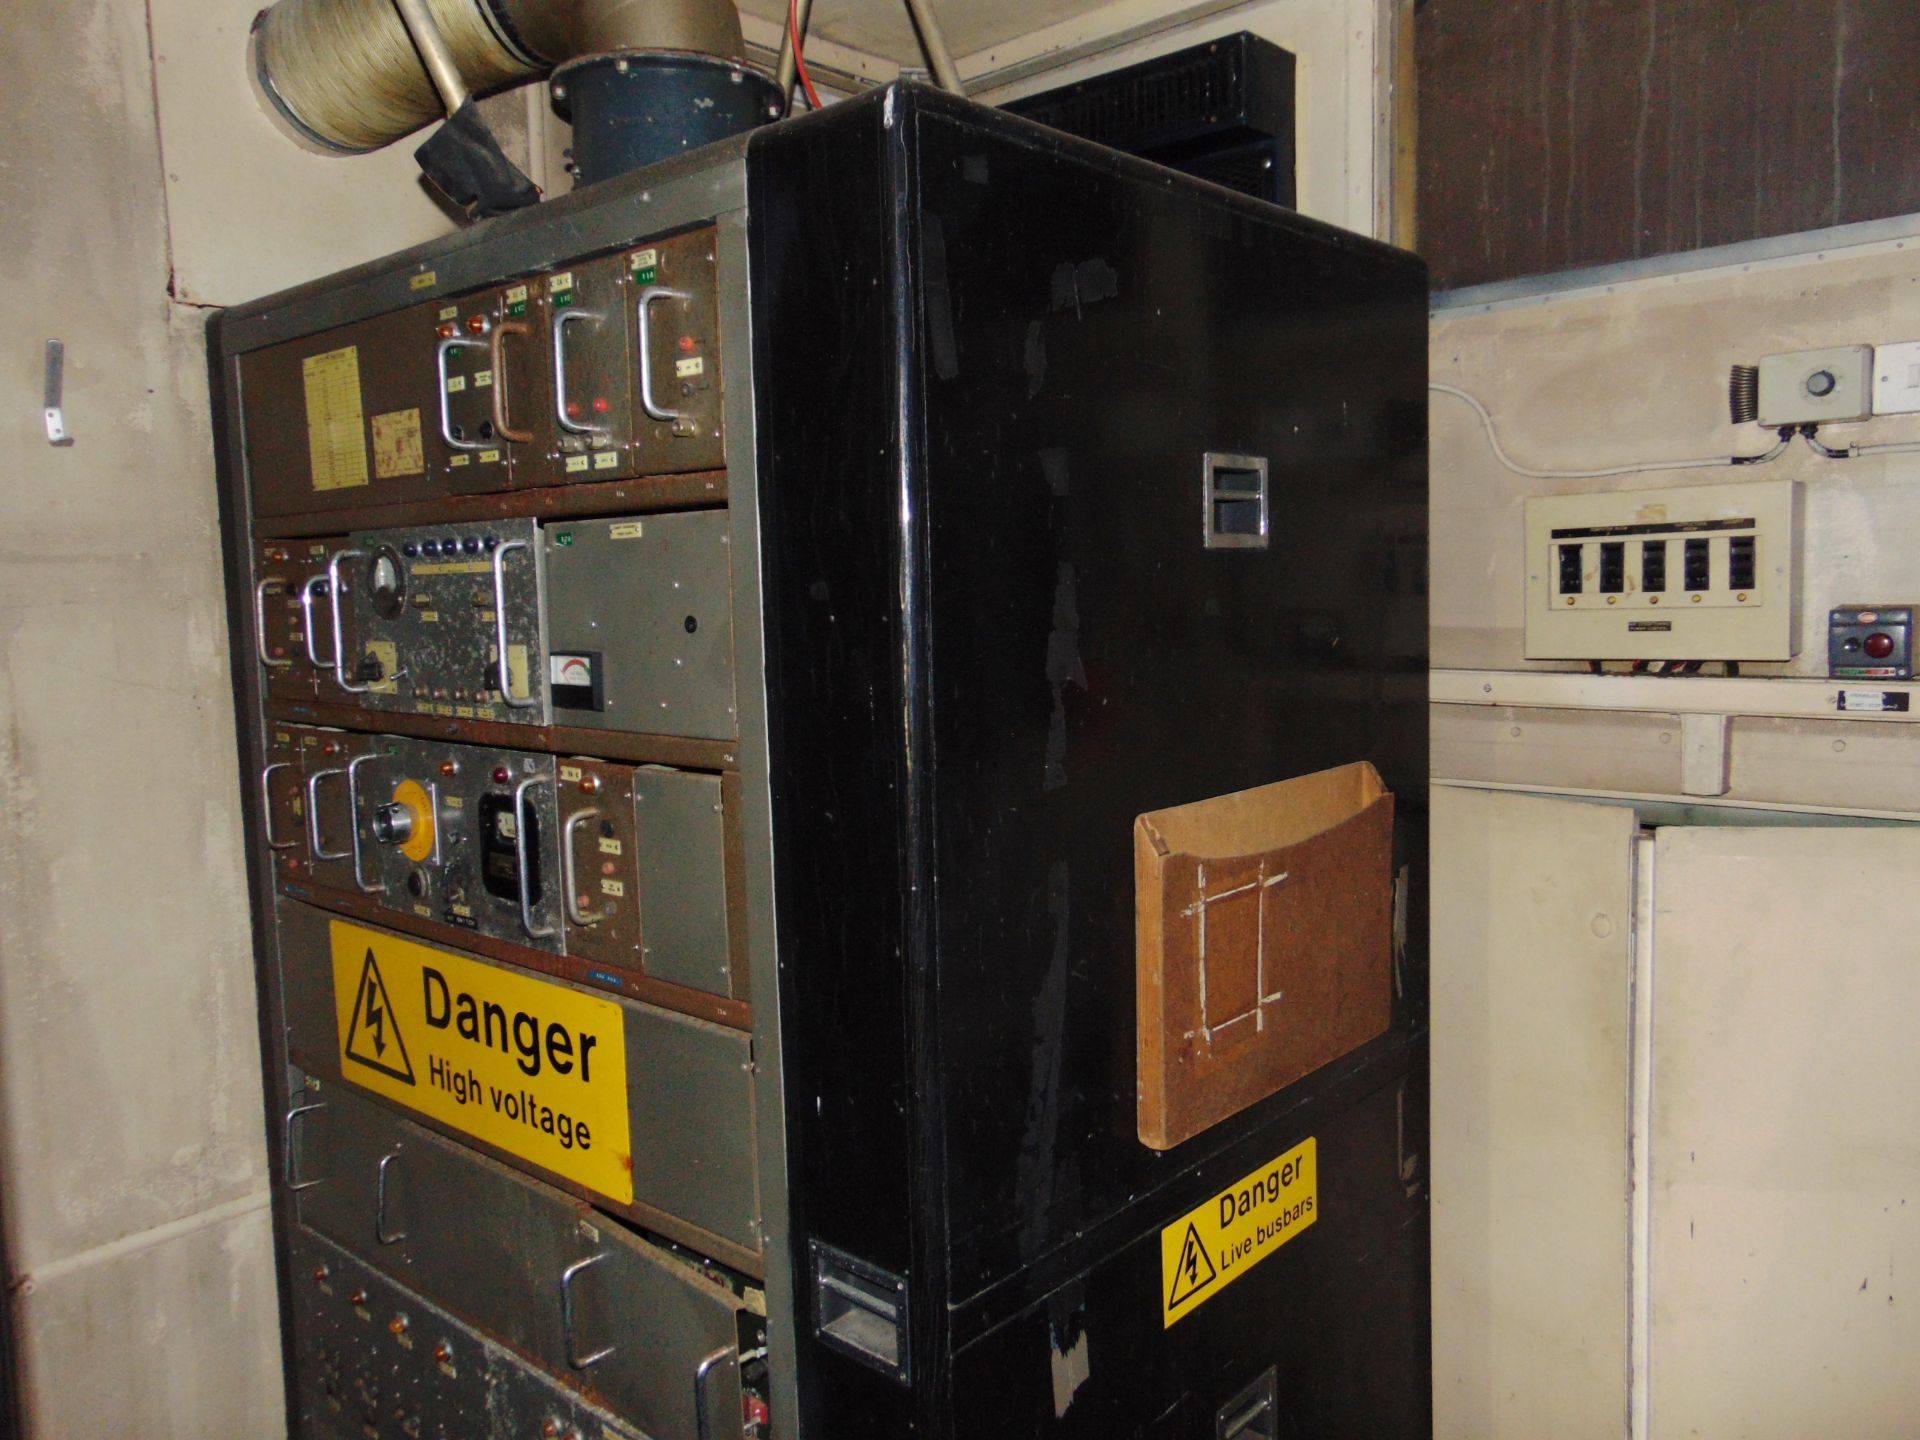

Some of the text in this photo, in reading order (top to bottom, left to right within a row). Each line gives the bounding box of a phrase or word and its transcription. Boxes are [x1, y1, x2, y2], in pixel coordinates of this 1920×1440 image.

[422, 966, 597, 1083] Danger
[429, 1054, 592, 1150] High voltage
[1220, 1154, 1303, 1230] Danger
[1221, 1196, 1313, 1271] Live busbars
